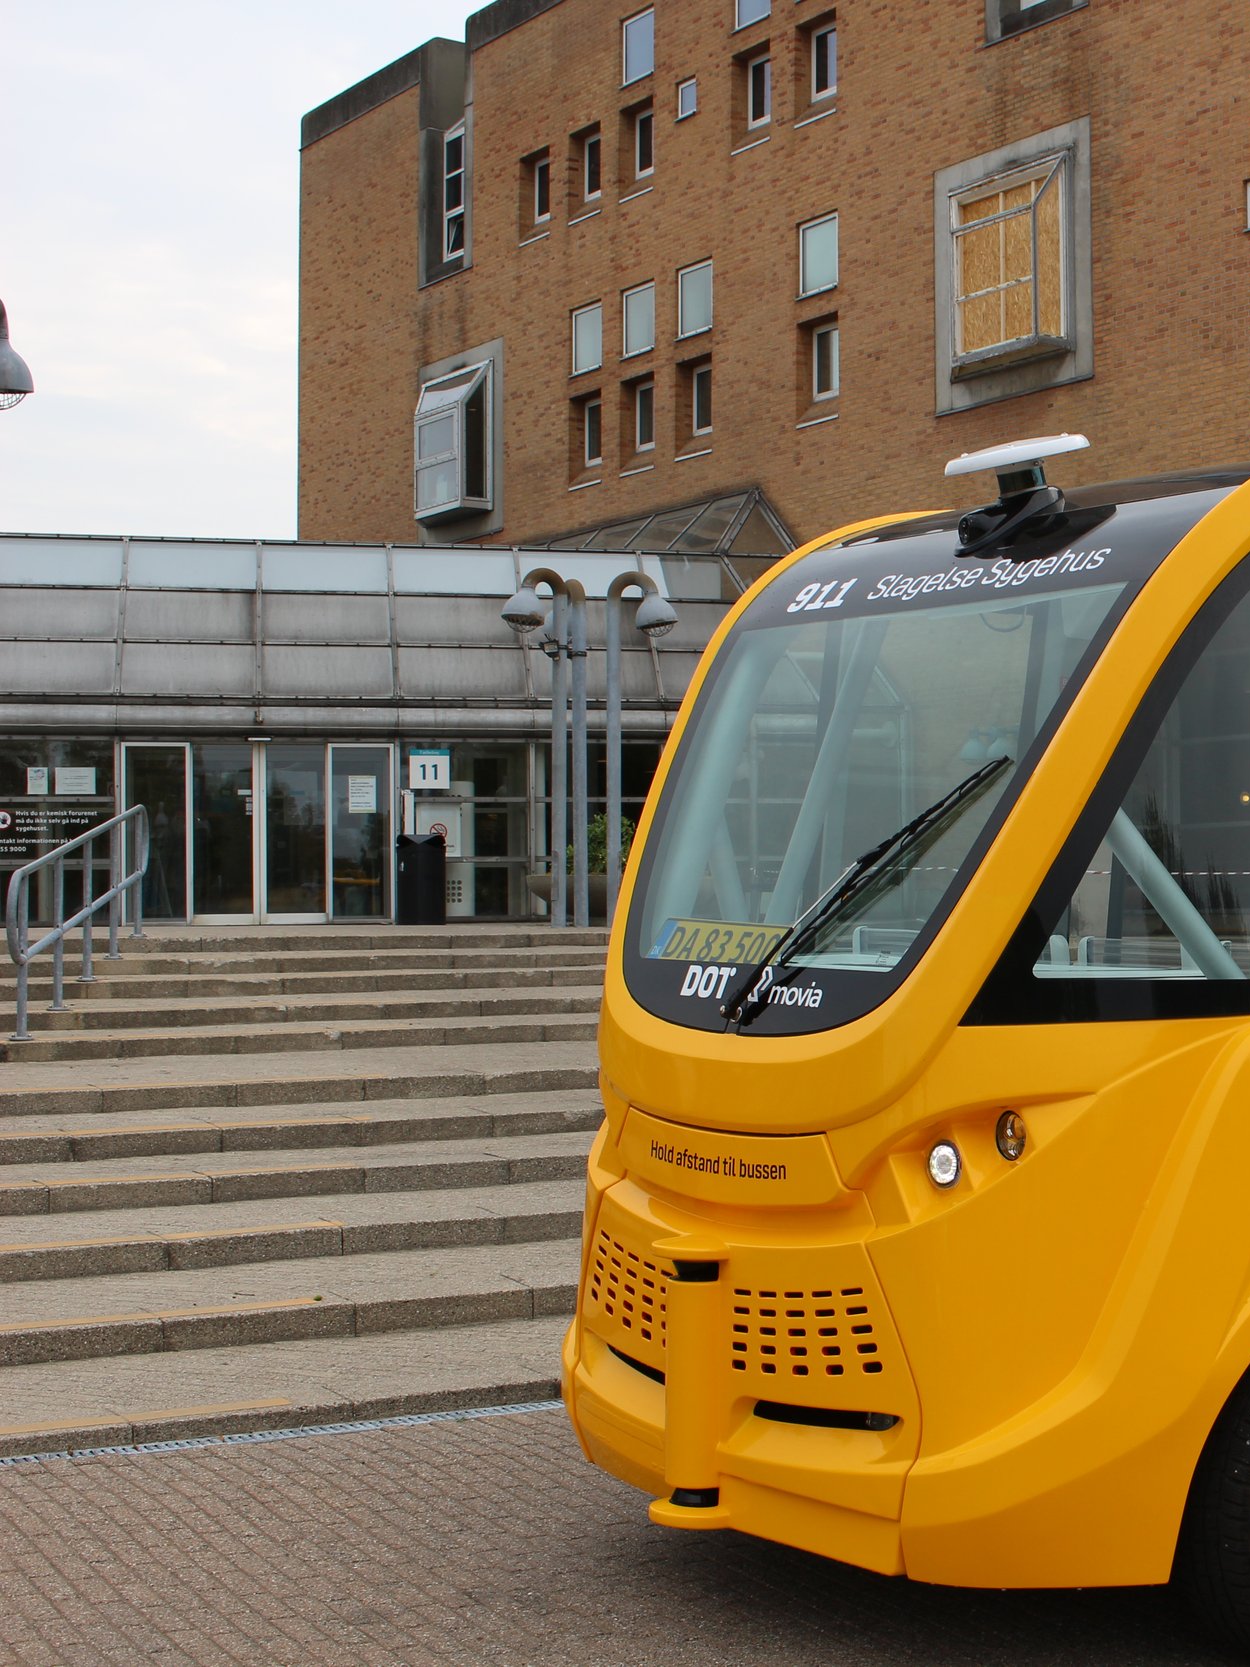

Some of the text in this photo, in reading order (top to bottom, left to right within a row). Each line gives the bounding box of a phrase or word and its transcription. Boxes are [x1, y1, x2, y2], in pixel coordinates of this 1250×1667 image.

[787, 548, 1111, 613] 911 Slagelse Sygehus
[419, 764, 438, 780] 11
[651, 945, 663, 955] DK
[661, 927, 701, 959] DA
[696, 928, 734, 963] 83
[680, 965, 737, 999] DOT
[768, 981, 823, 1008] movia
[650, 1140, 787, 1180] Hold afstand til bussen
